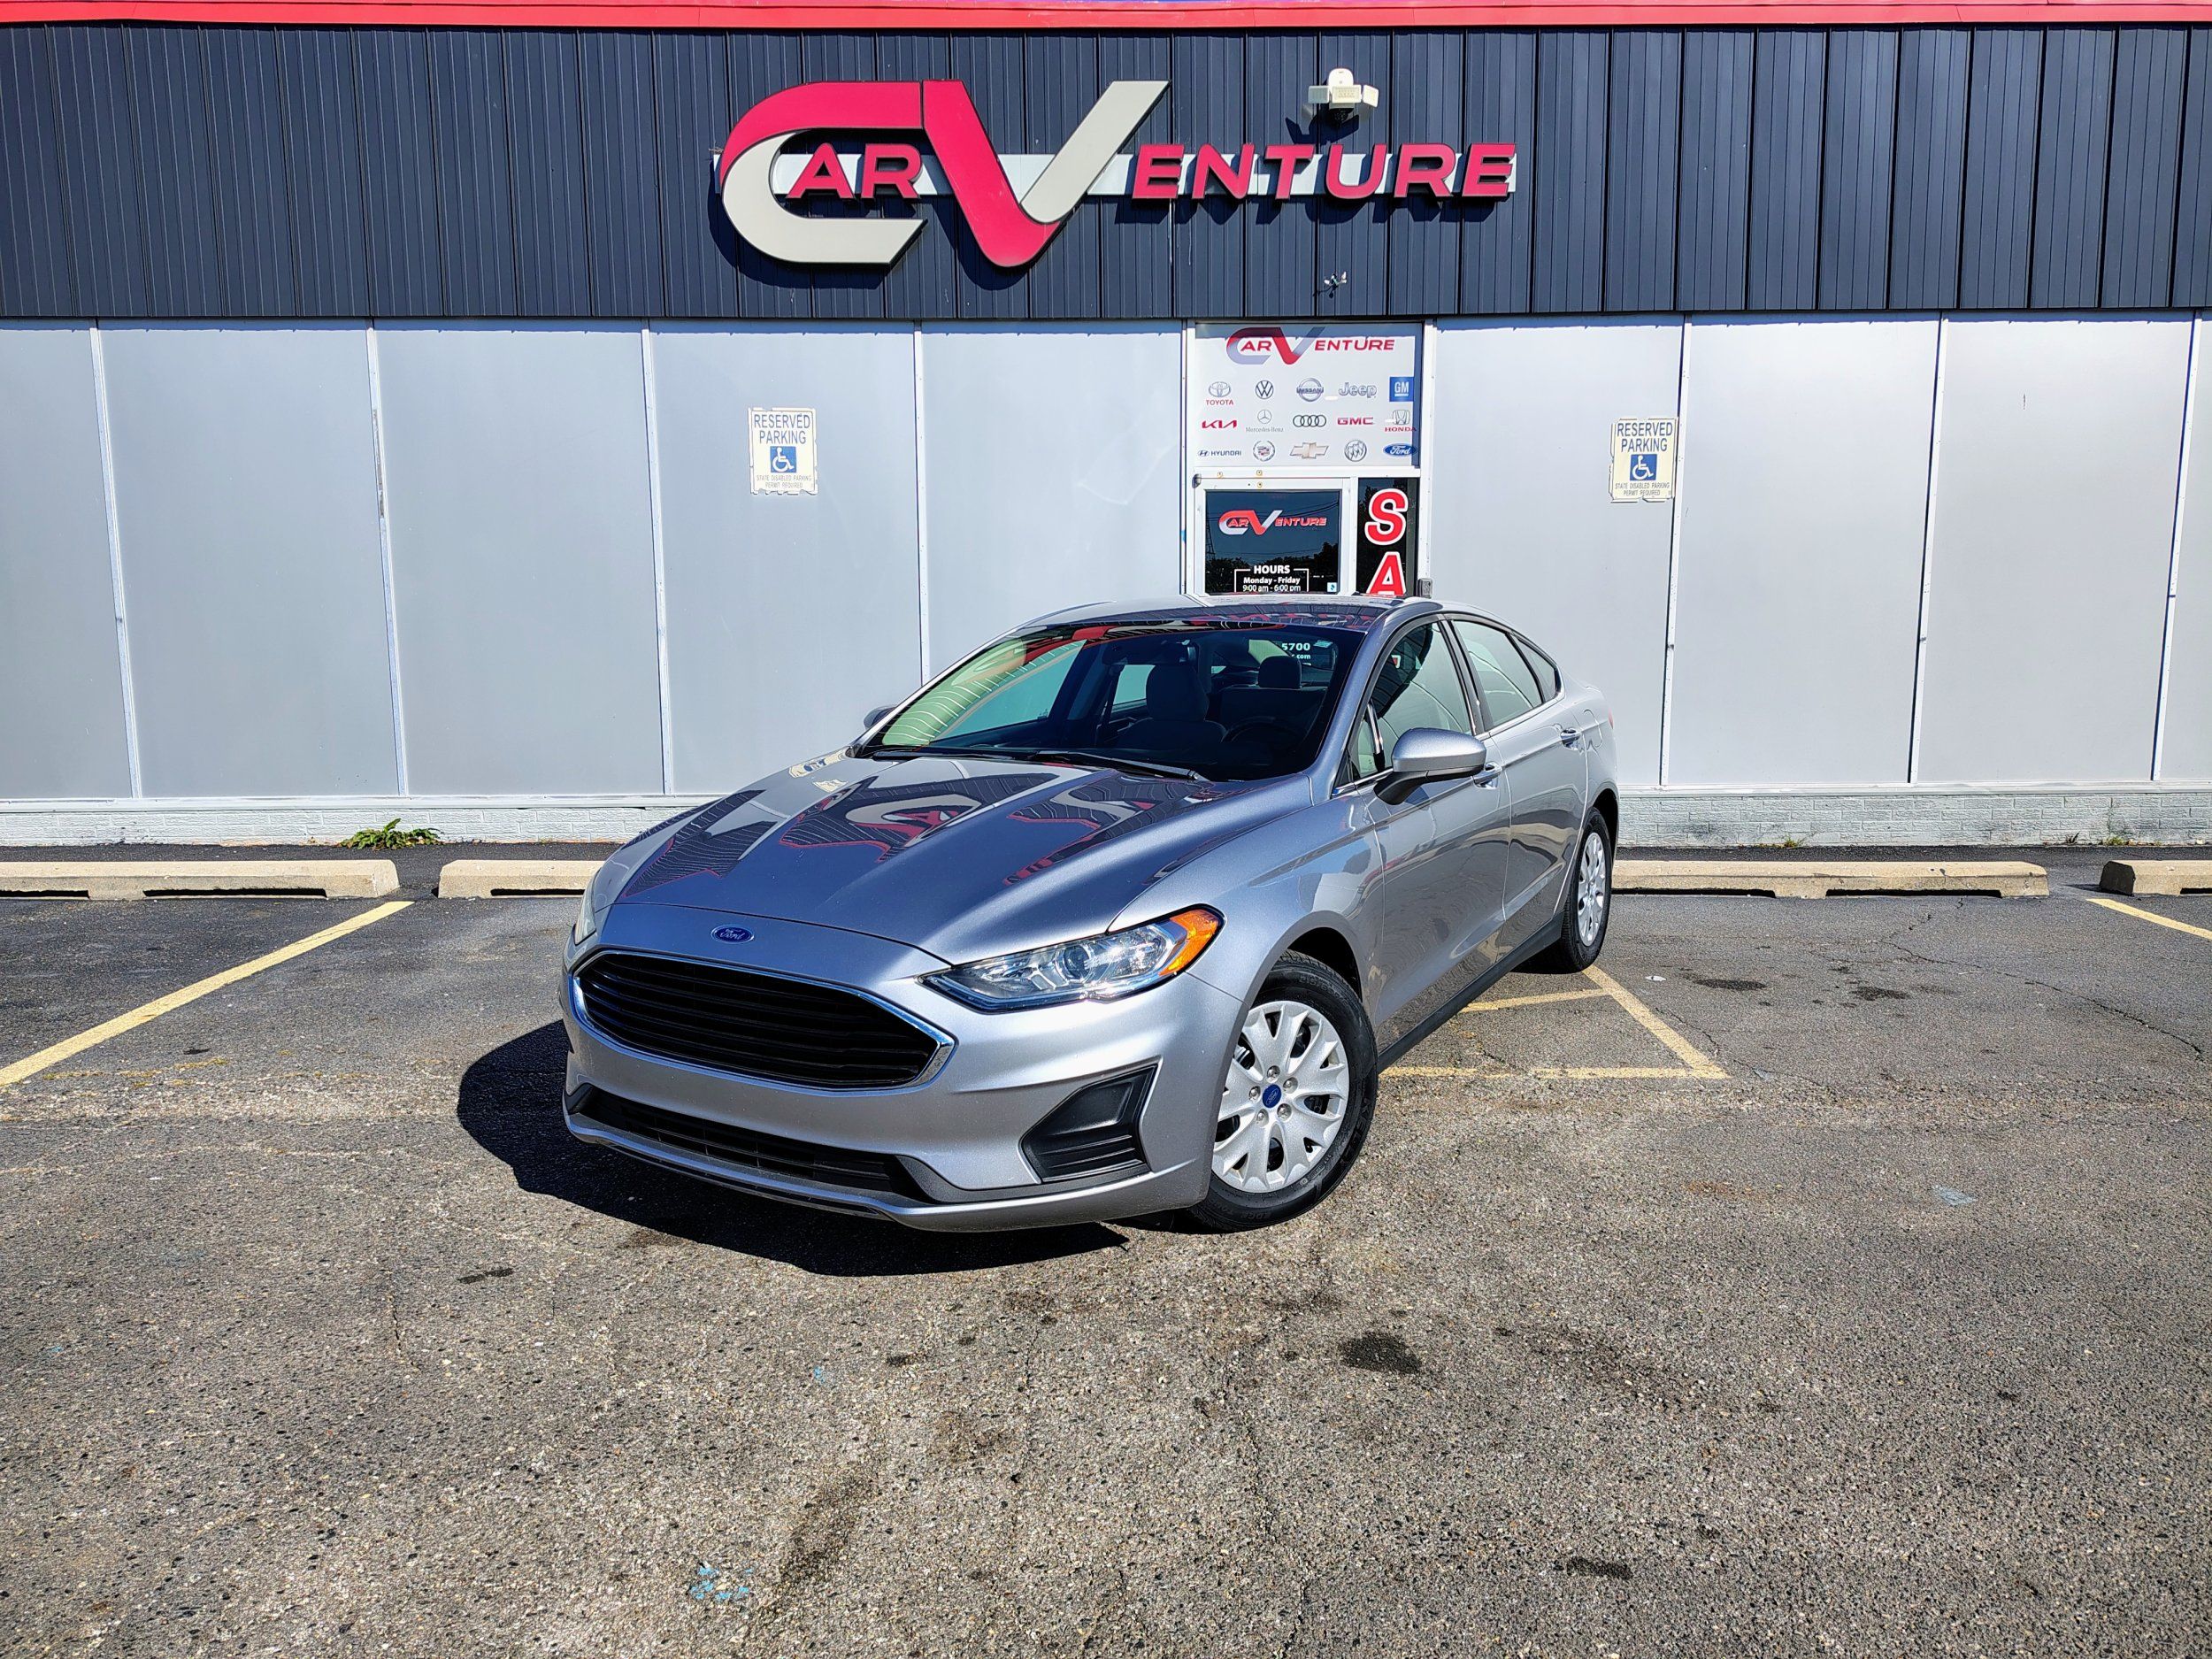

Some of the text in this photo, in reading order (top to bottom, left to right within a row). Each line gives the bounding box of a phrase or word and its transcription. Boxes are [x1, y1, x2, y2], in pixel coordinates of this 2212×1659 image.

[1338, 381, 1378, 398] Jeep
[1394, 381, 1409, 394] GM
[754, 413, 811, 429] RESERVED
[1337, 417, 1374, 426] GMC
[1617, 421, 1673, 437] RESERVED
[759, 430, 807, 445] PARKING
[1389, 444, 1411, 455] Ford
[1621, 438, 1668, 453] PARKING
[1253, 565, 1291, 574] HOURS
[1278, 576, 1301, 585] Friday
[1281, 642, 1311, 651] 5700
